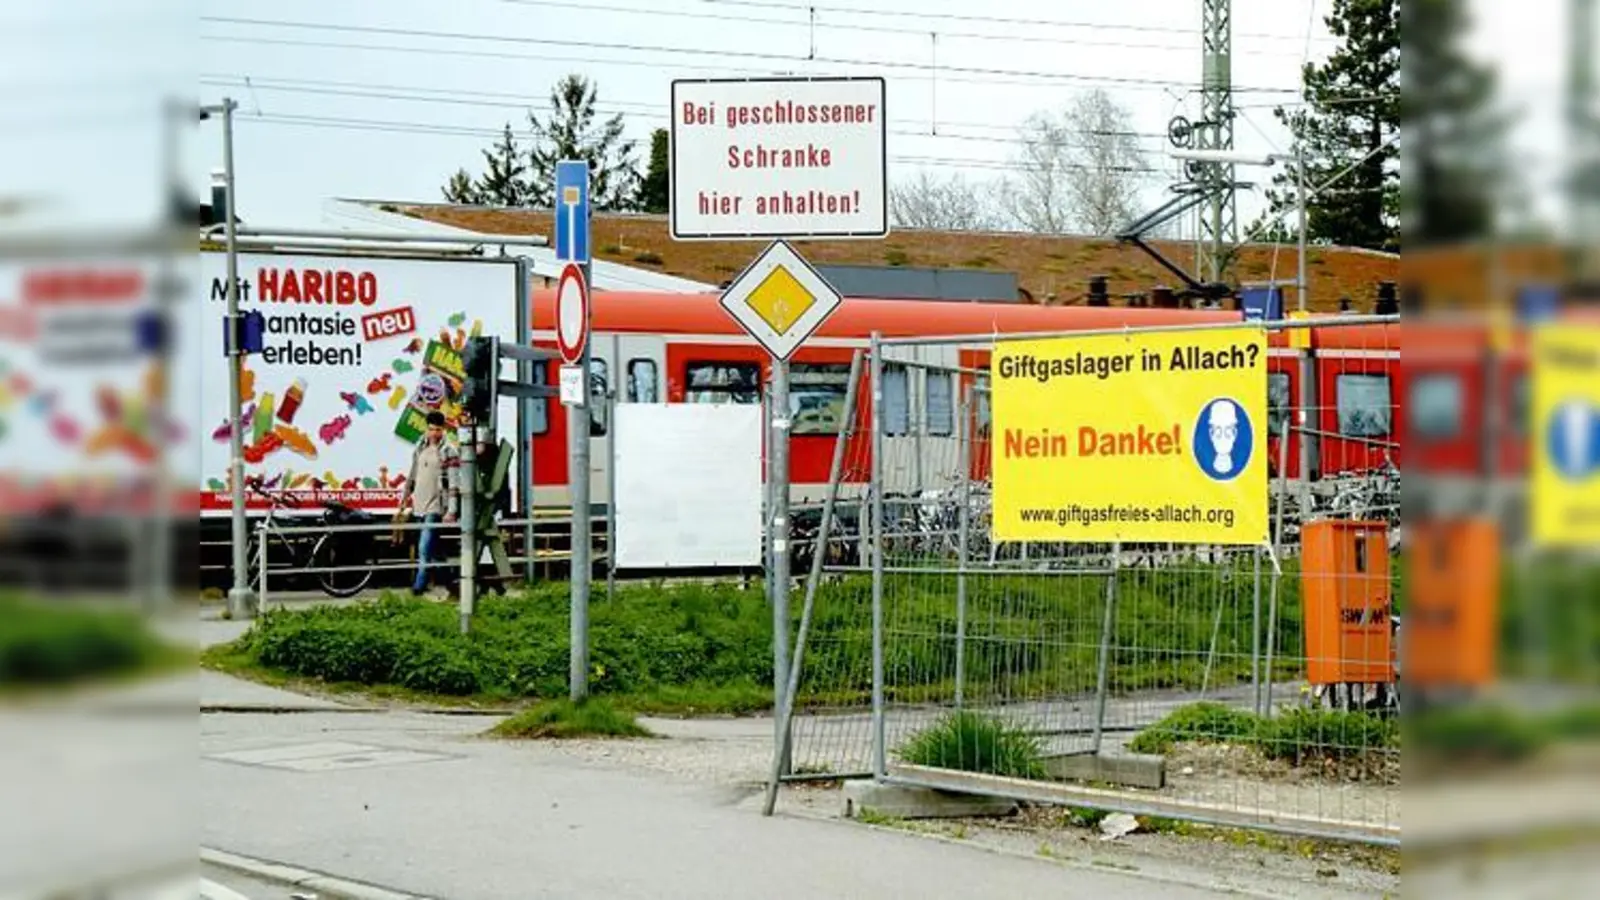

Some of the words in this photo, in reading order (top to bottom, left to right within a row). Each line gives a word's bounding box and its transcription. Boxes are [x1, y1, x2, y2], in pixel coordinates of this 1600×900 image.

[683, 101, 715, 126] Bei
[727, 100, 876, 128] geschlossener
[728, 144, 831, 168] Schranke
[699, 192, 742, 215] hier
[756, 190, 860, 215] anhalten!
[211, 277, 251, 301] Mit
[258, 268, 377, 306] HARIBO
[364, 307, 413, 339] neu
[262, 339, 362, 366] erleben!
[999, 352, 1134, 382] Giftgaslager
[1142, 349, 1161, 371] in
[1169, 343, 1259, 371] Allach?
[1004, 428, 1067, 459] Nein
[1078, 424, 1182, 457] Danke!
[1020, 504, 1234, 527] www.giftgasfreies-allach.org
